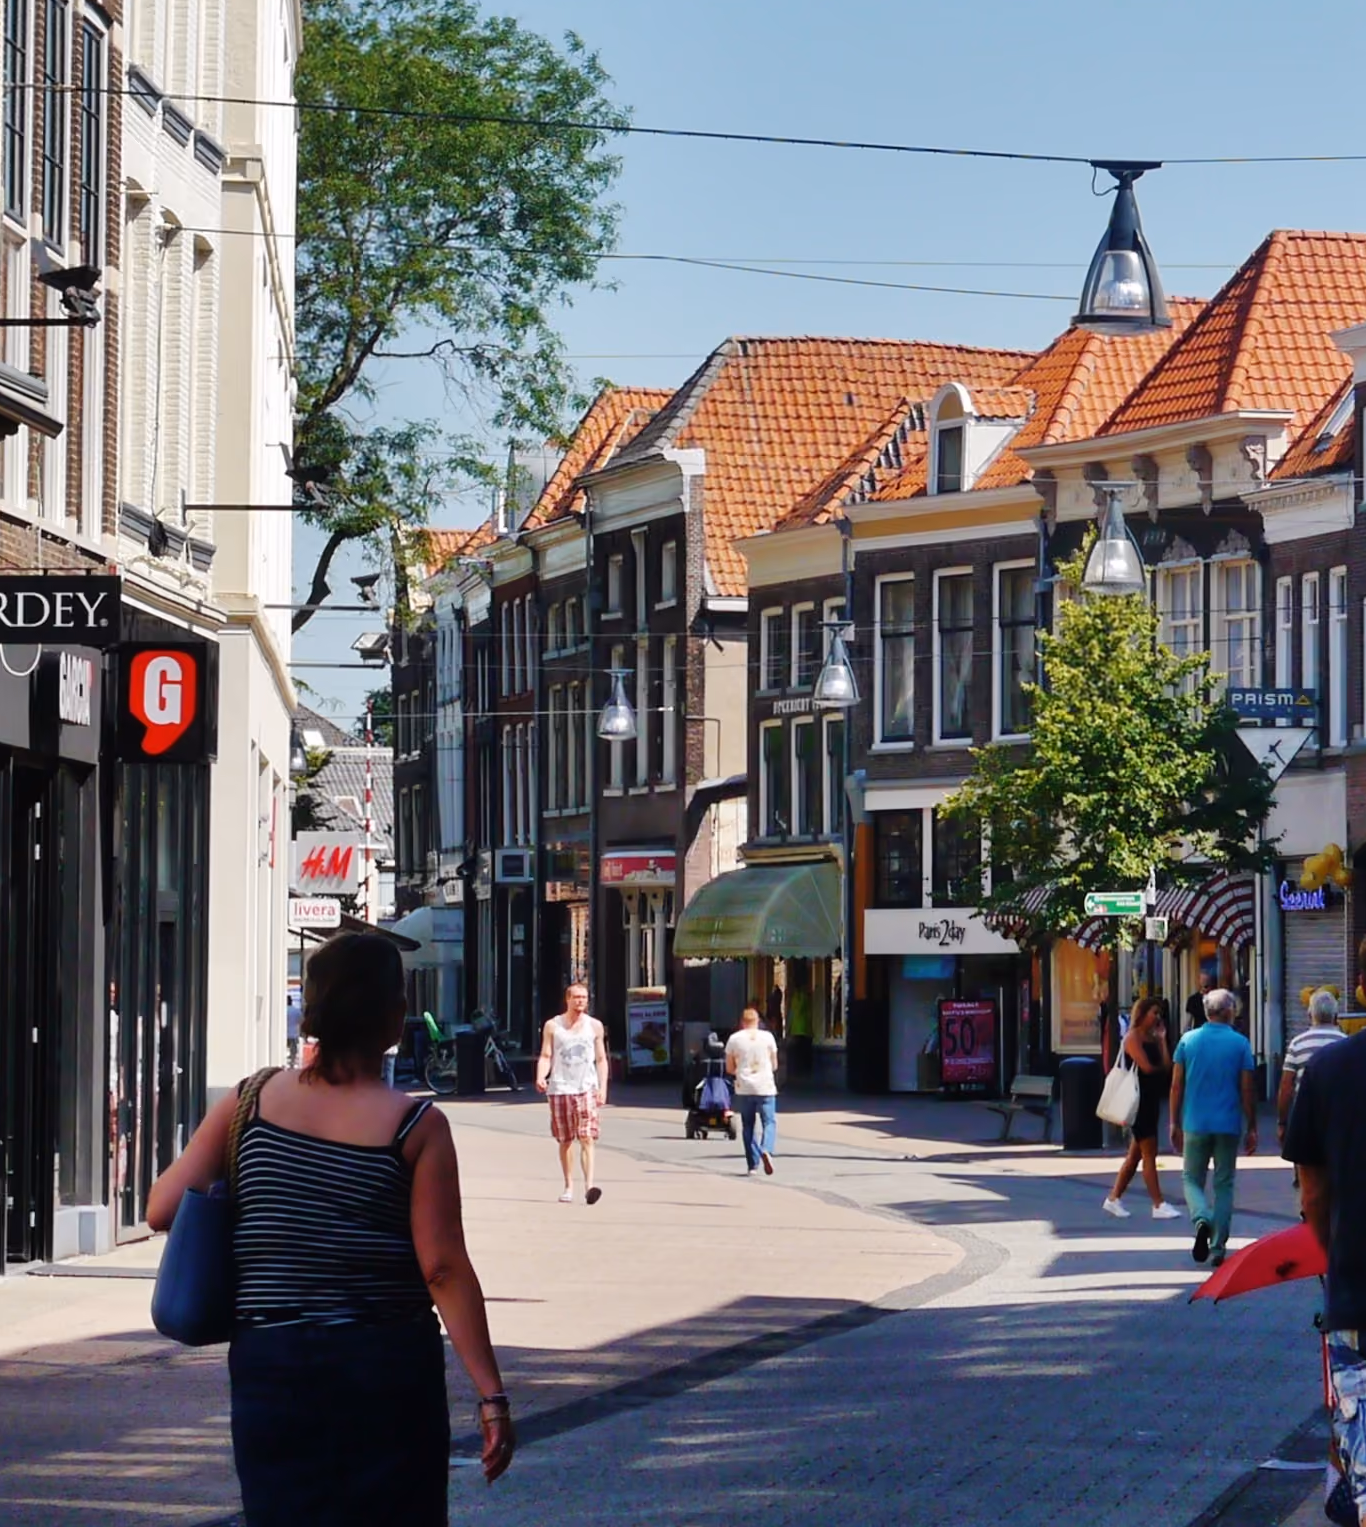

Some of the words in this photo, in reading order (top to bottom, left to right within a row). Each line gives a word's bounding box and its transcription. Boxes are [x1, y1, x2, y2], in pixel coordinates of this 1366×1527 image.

[143, 655, 183, 725] G
[300, 845, 353, 881] H&M
[294, 901, 337, 916] livera
